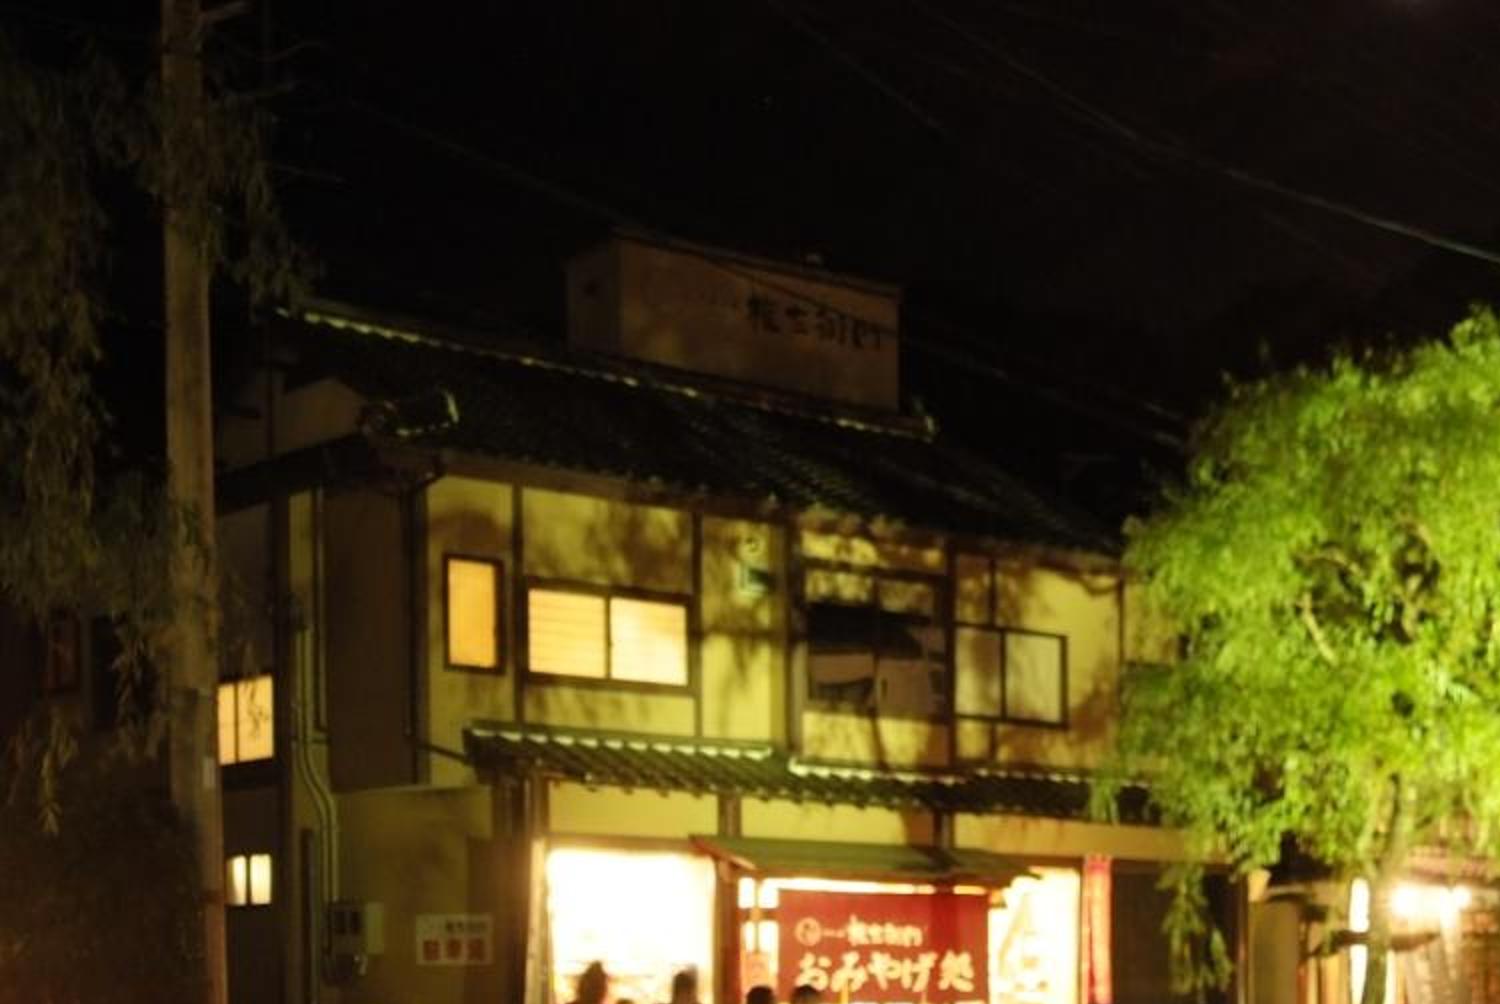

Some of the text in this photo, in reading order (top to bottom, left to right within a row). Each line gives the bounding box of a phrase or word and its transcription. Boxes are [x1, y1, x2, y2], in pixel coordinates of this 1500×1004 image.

[794, 951, 975, 993] おみやげ処
